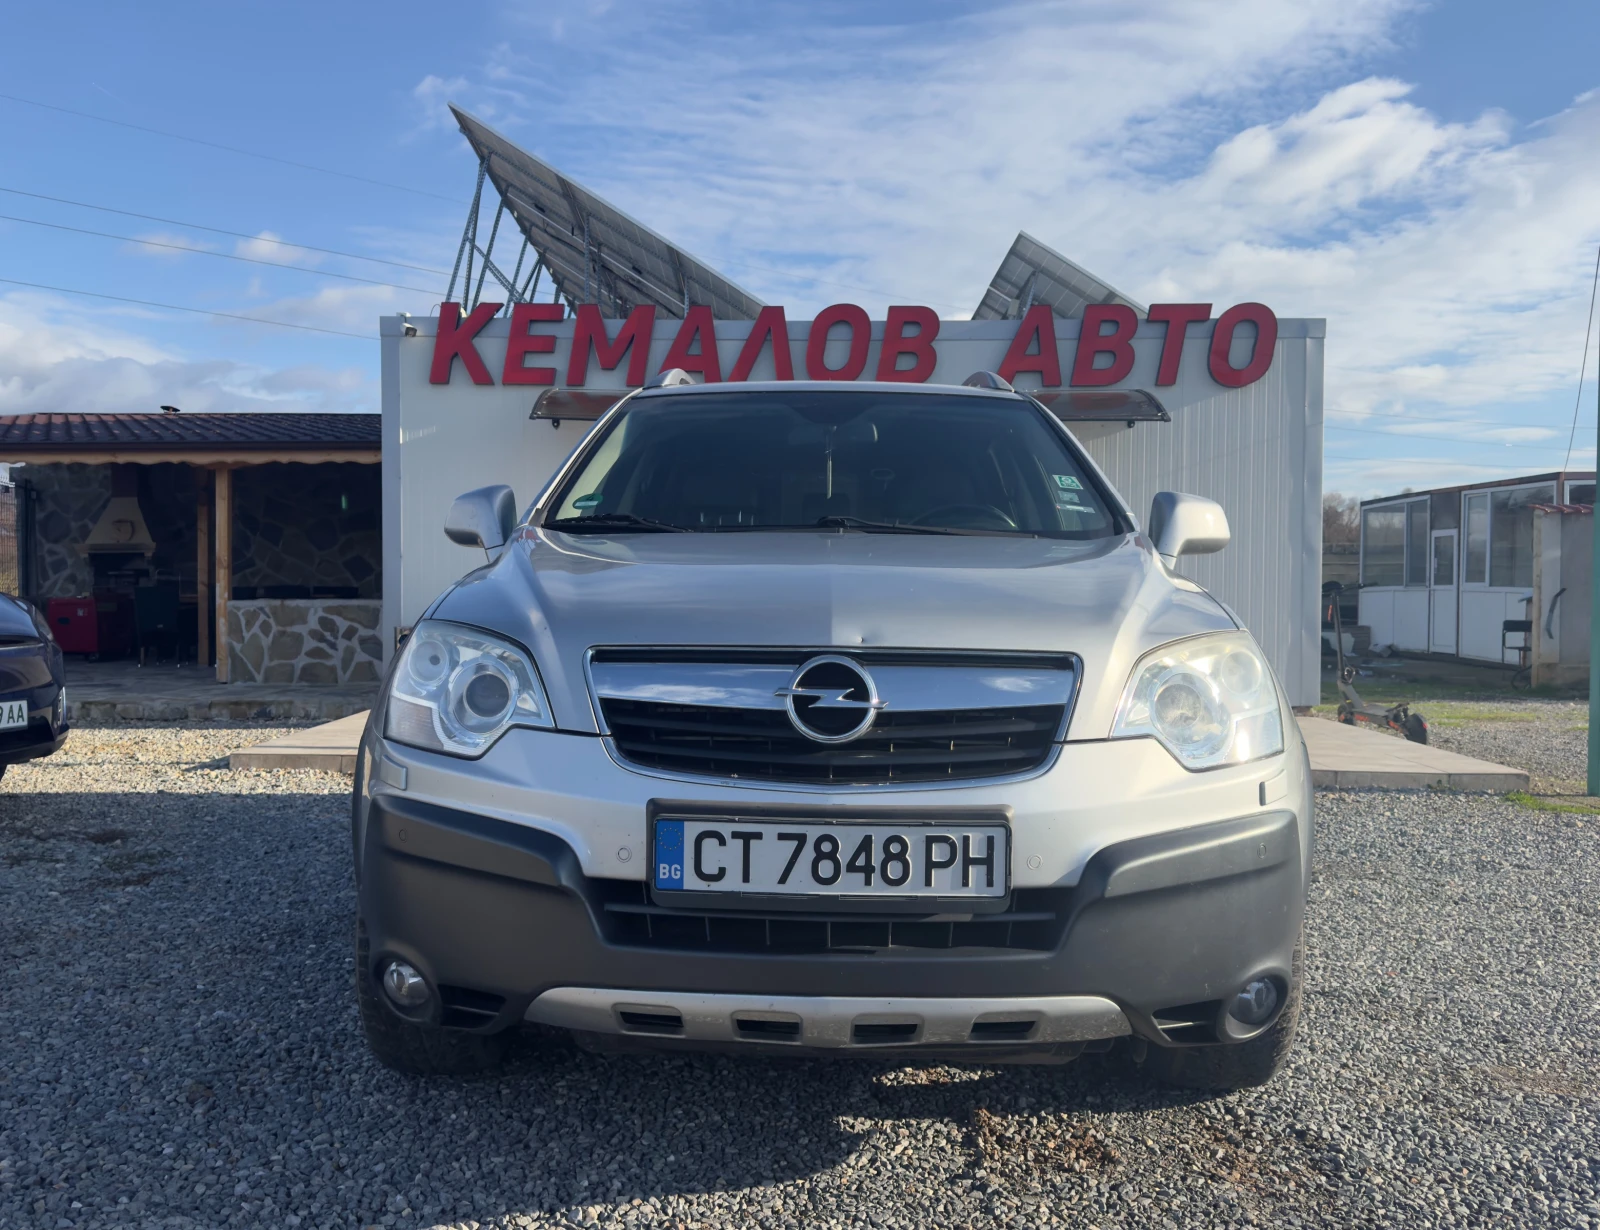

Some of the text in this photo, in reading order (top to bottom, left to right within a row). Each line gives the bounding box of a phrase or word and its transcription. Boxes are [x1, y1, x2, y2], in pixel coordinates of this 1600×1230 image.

[430, 302, 1278, 388] КЕМАЛОВ АВТО
[659, 863, 681, 880] BG
[693, 830, 995, 888] CT 7848 PH
